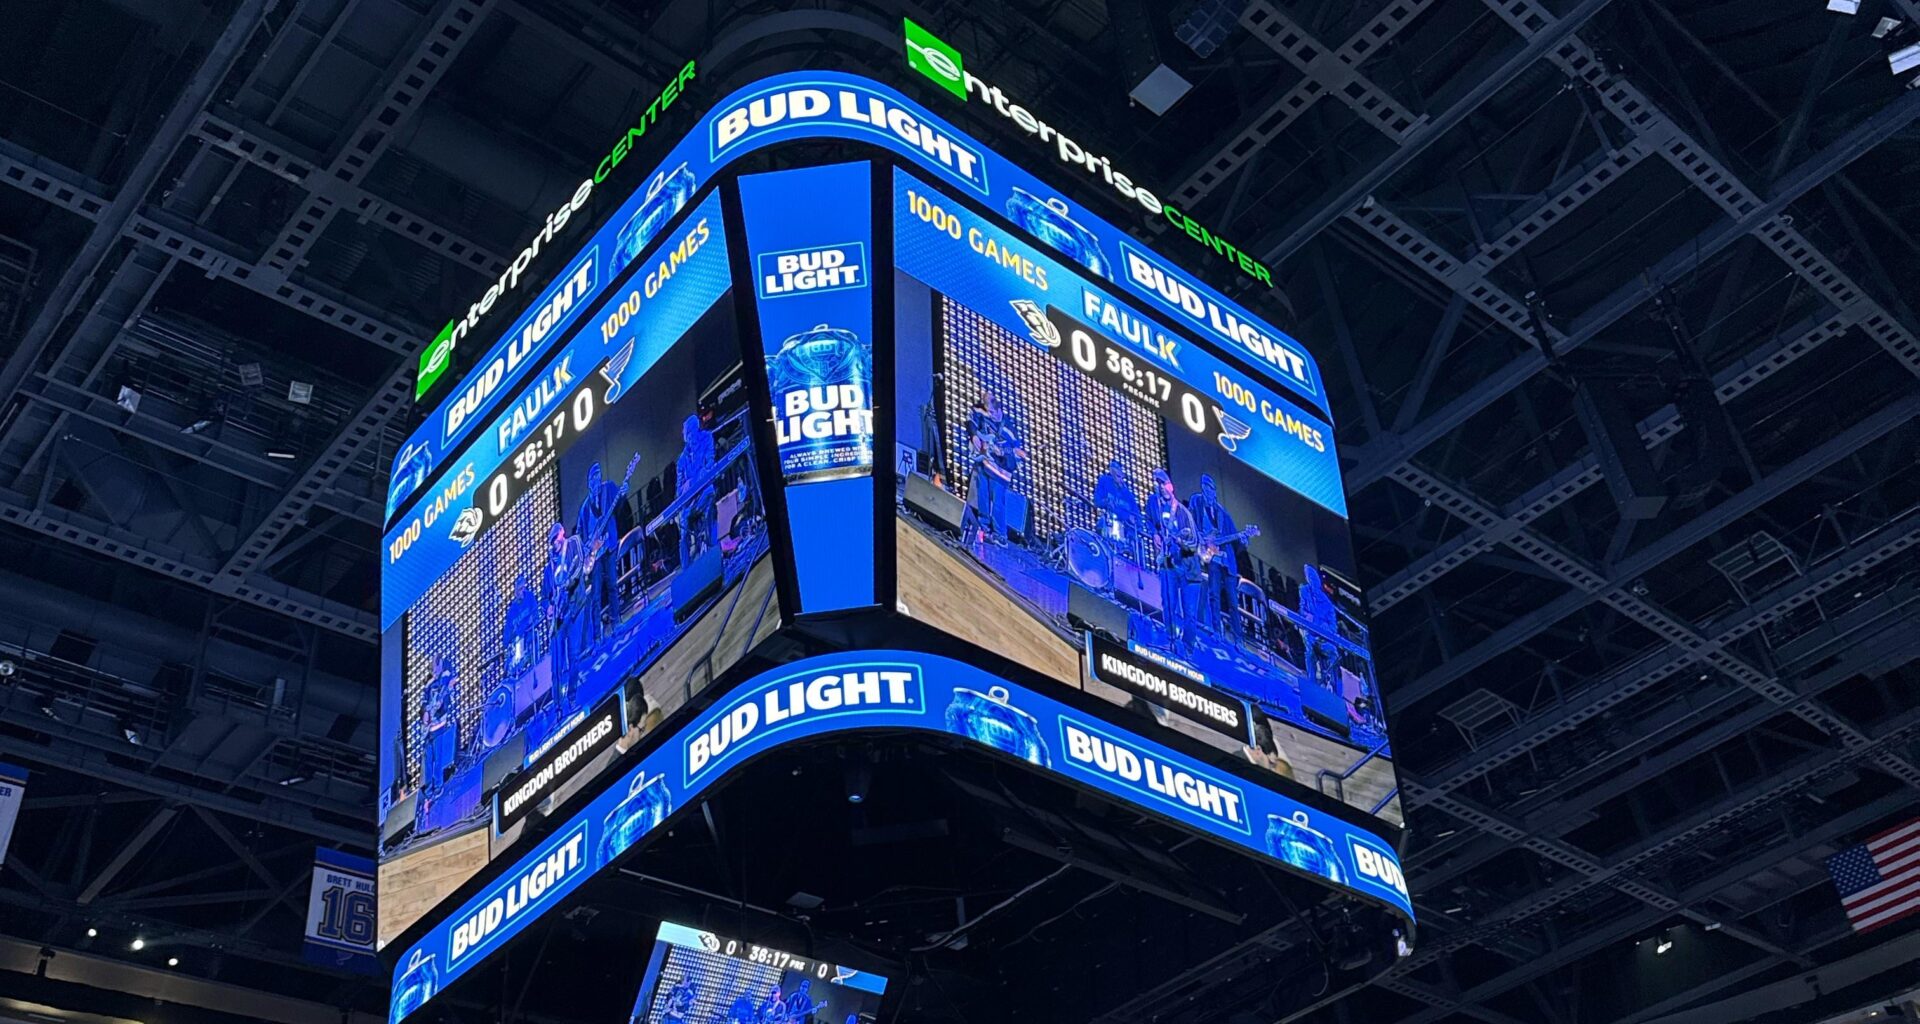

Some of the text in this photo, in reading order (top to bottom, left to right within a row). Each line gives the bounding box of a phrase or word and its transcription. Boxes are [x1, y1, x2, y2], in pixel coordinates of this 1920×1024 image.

[717, 89, 981, 182] BUD LIGHT
[907, 38, 1274, 288] enterprise CENTER
[417, 59, 696, 384] enterprise CENTER
[777, 249, 845, 274] BUD
[907, 189, 1048, 292] 1000 GAMES
[600, 217, 711, 345] 1000 GAMES
[765, 265, 860, 295] LIGHT
[1129, 251, 1306, 383] BUD LIGHT
[446, 259, 593, 437] BUD LIGHT
[1071, 329, 1206, 434] 0 36:17 0
[777, 410, 873, 445] LIGHT
[785, 384, 864, 417] BUD
[1213, 371, 1325, 453] 1000 GAMES
[489, 387, 593, 517] 0 36:17 0
[389, 462, 476, 565] 1000 GAMES
[1101, 653, 1239, 728] KINGDOM BROTHERS
[1134, 644, 1205, 682] BUD LIGHT HAPPY HOUR
[503, 714, 613, 817] KINGDOM BROTHERS
[688, 670, 912, 777] BUD LIGHT
[1066, 725, 1240, 823] BUD LIGHT
[317, 885, 376, 946] 16
[327, 874, 352, 888] BRETT
[451, 831, 583, 961] BUD LIGHT
[1353, 843, 1407, 895] BUD
[725, 940, 828, 978] 0 36:17 PRE 0
